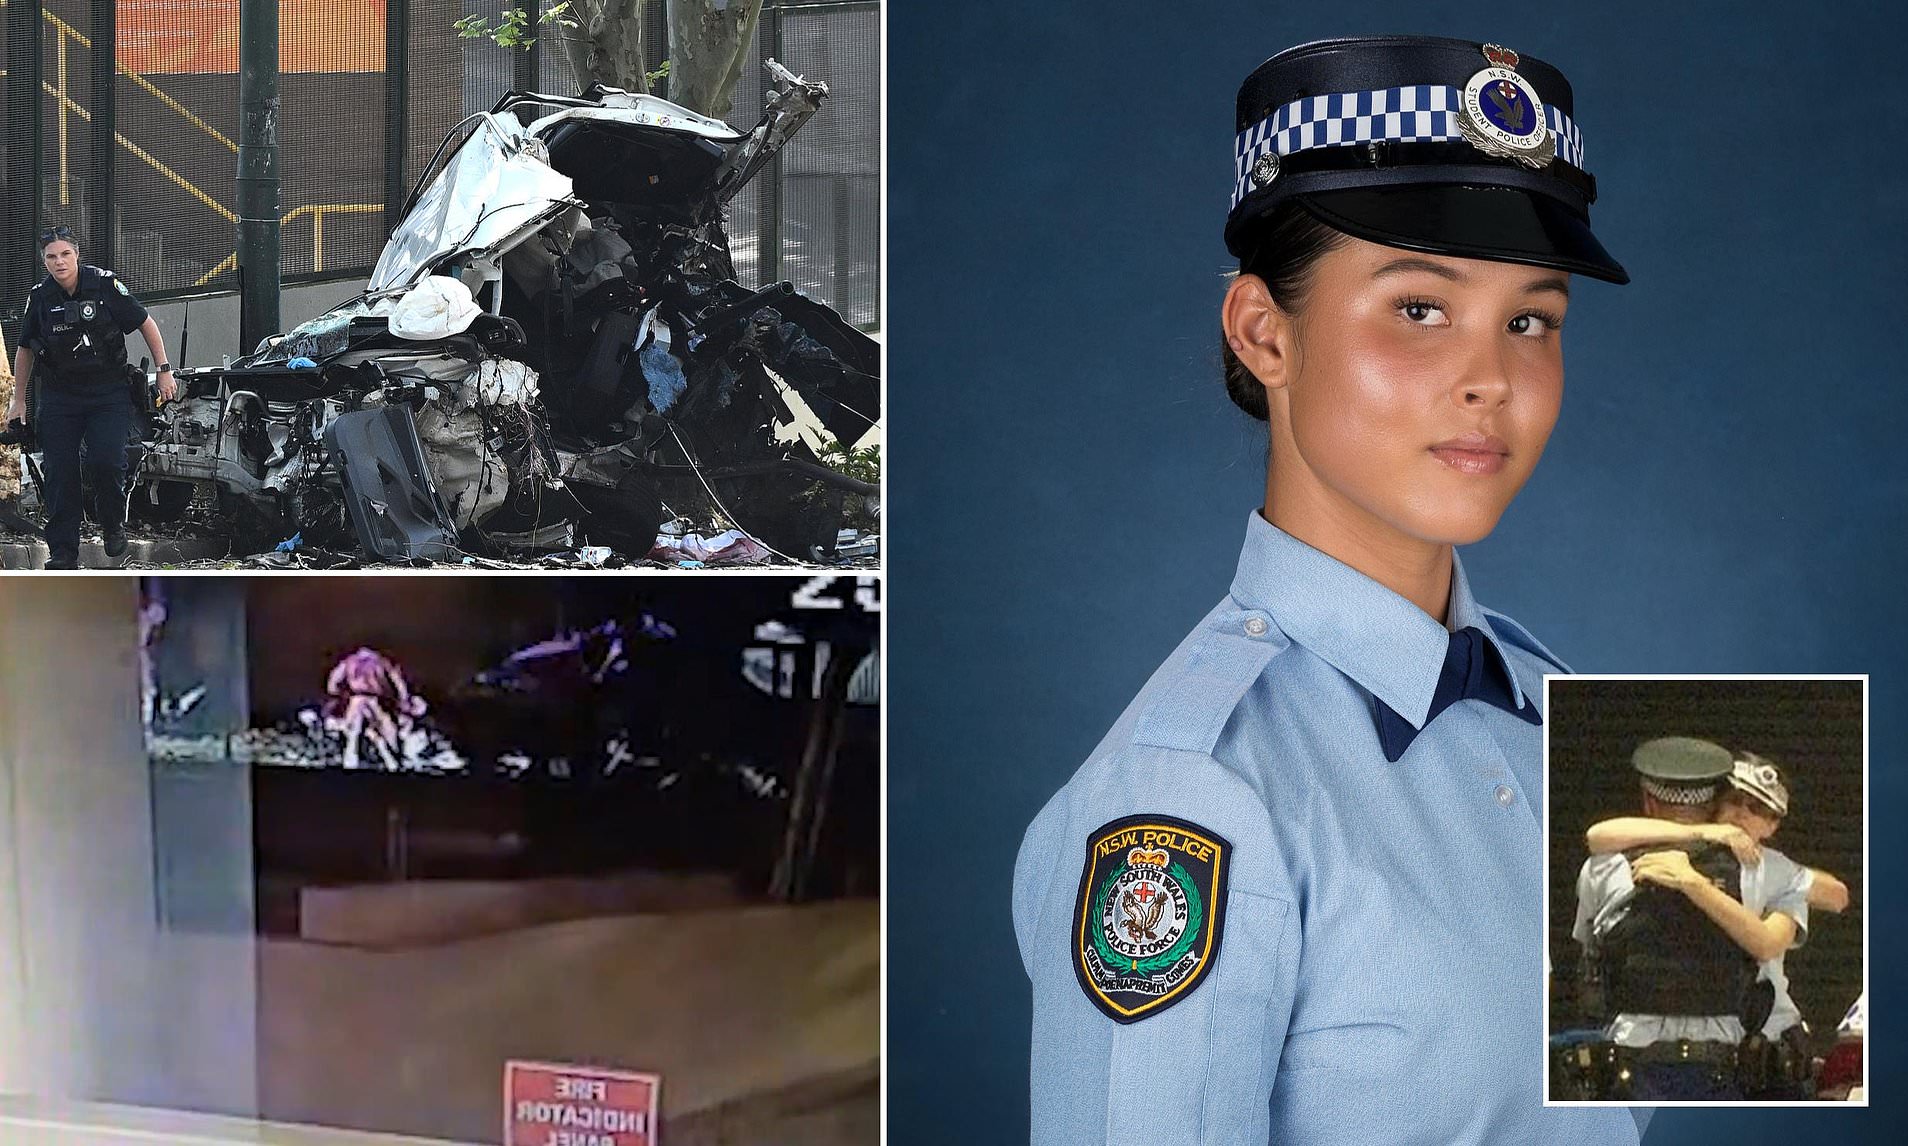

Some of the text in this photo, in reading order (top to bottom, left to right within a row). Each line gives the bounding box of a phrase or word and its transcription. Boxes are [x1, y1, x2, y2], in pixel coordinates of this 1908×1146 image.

[1488, 70, 1522, 86] N.S.W.
[1469, 86, 1545, 146] STUDENT POLICE OFFICER
[1143, 831, 1213, 863] POLICE
[1104, 870, 1186, 921] NEW SOUTH WALES
[1104, 922, 1180, 955] POLICE FORCE
[1165, 955, 1195, 984] COMES
